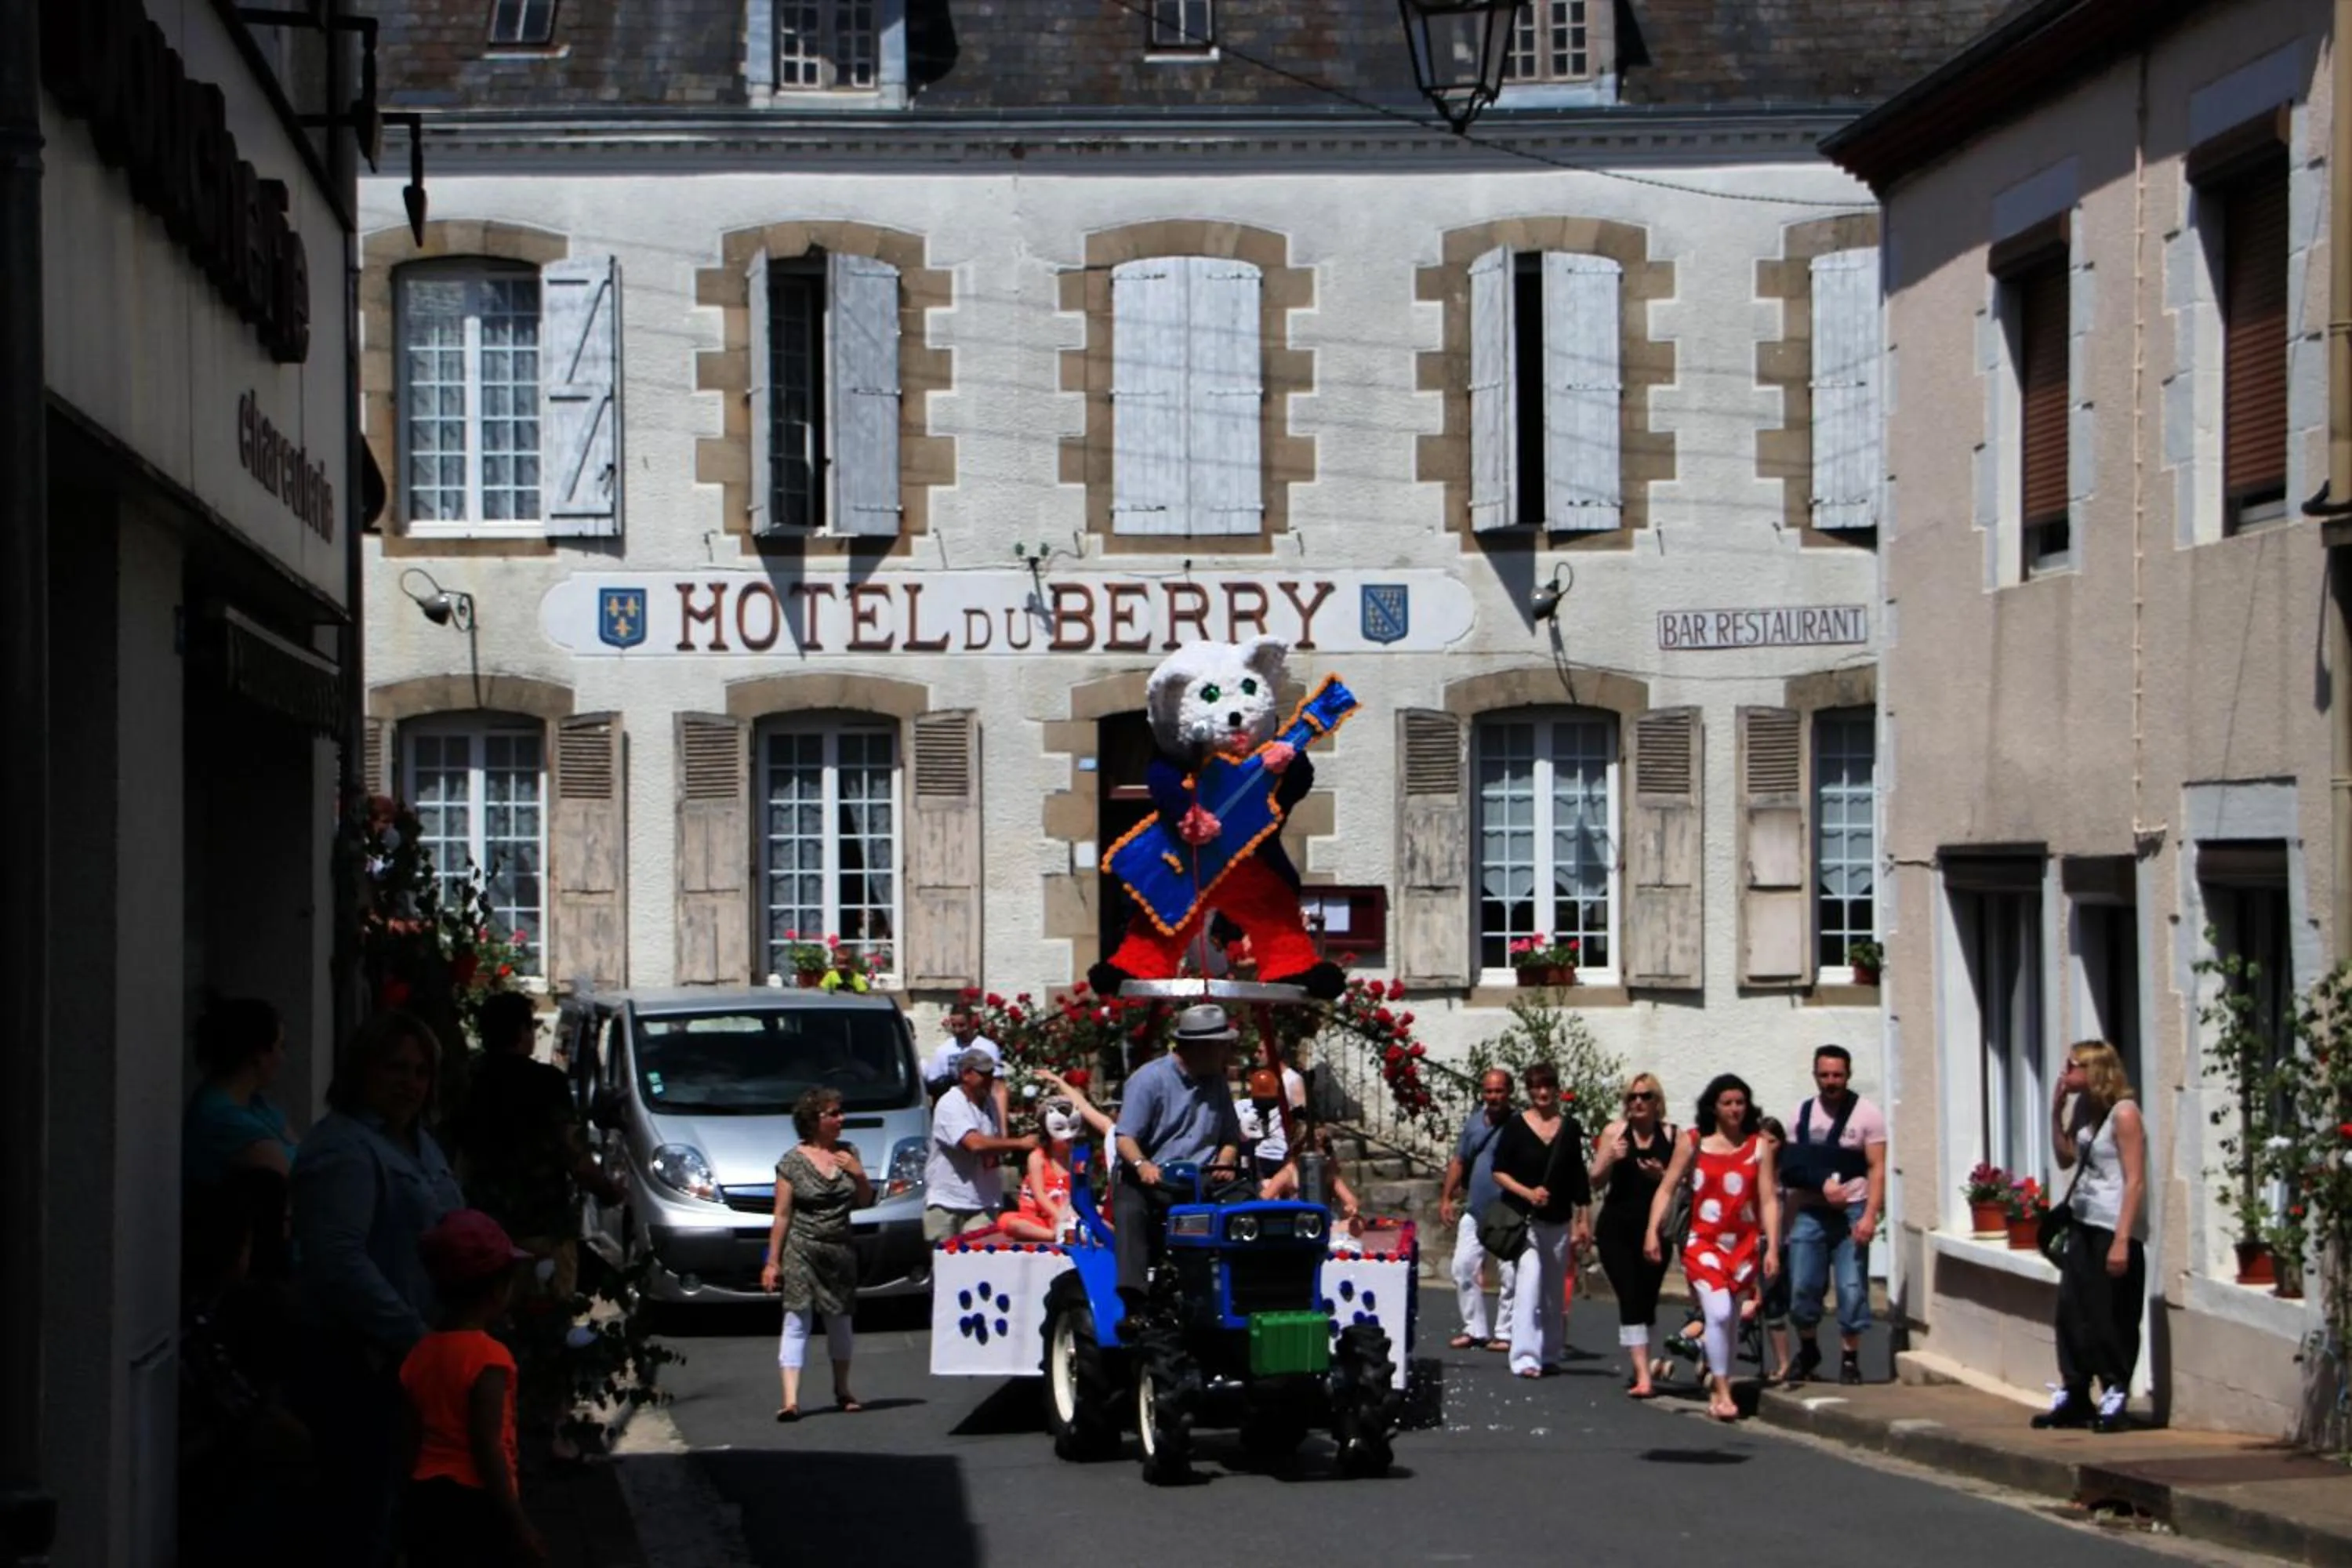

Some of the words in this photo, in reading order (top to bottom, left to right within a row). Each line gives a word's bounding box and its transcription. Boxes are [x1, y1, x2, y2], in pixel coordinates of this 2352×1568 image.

[675, 581, 951, 652] HOTEL
[963, 608, 1033, 651] DU
[1047, 582, 1335, 652] BERRY
[1662, 614, 1707, 647] BAR
[1715, 608, 1862, 644] RESTAURANT
